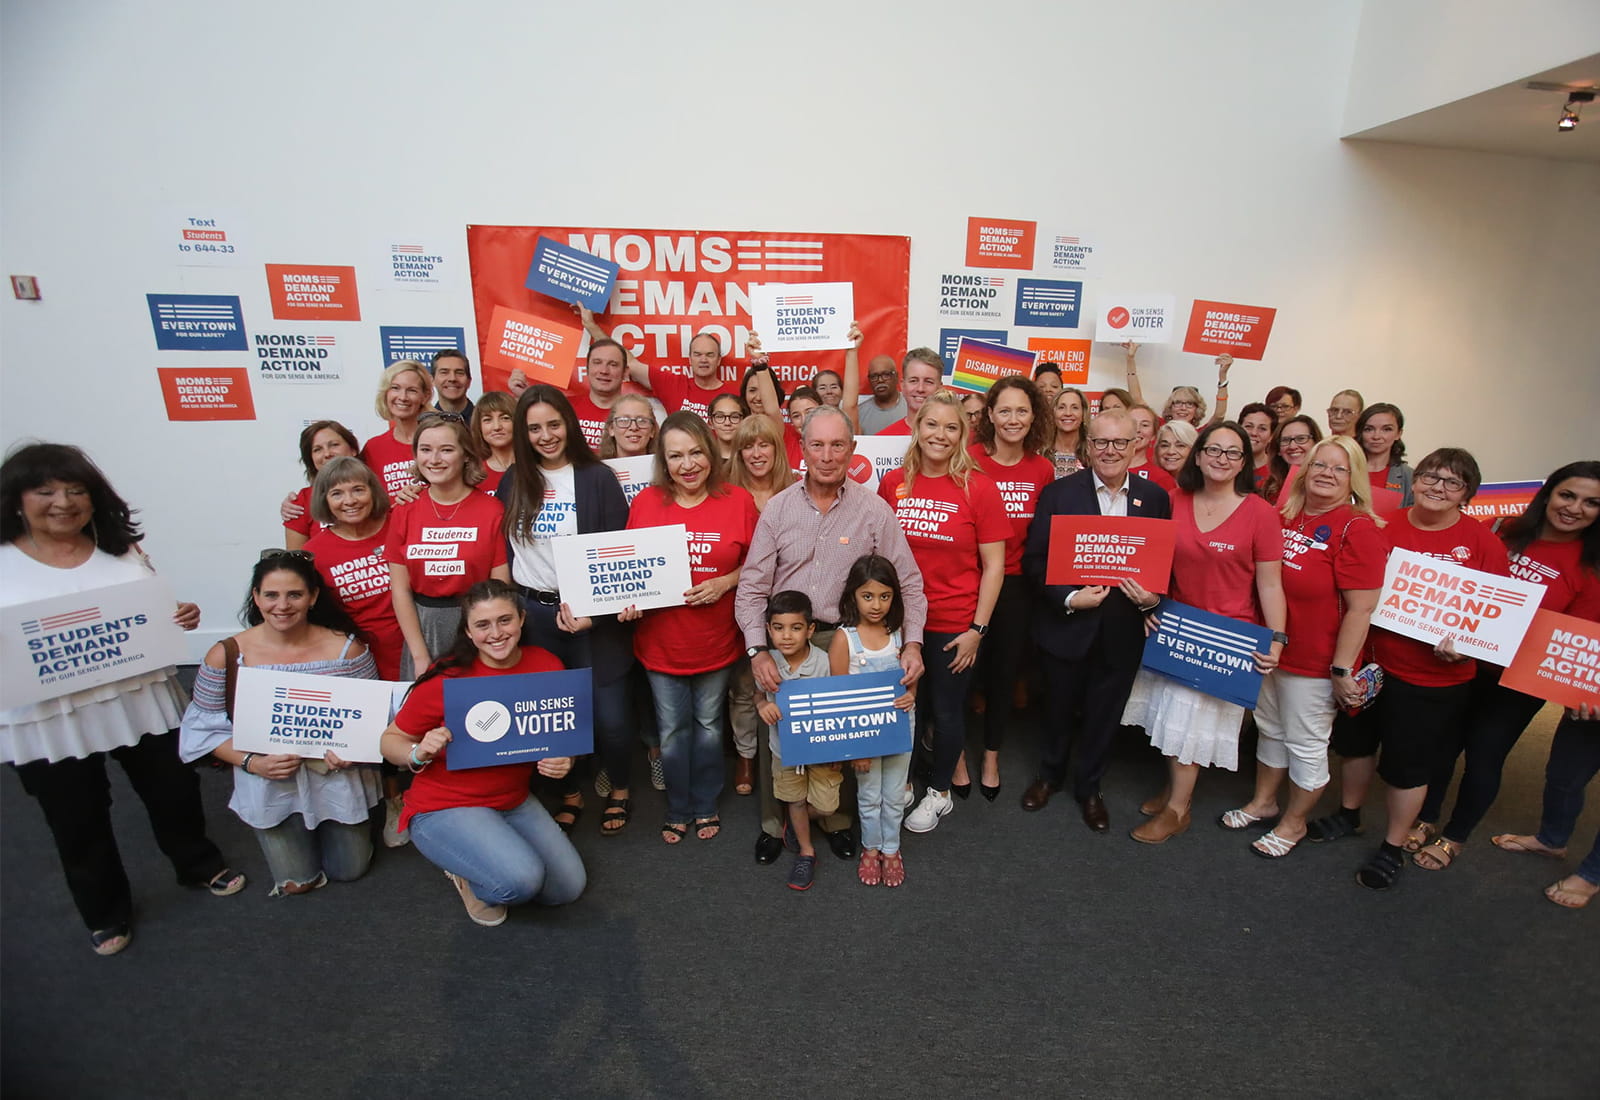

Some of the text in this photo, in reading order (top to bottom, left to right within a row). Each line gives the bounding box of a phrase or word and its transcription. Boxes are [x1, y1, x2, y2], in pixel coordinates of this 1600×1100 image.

[188, 218, 216, 227] Text
[186, 232, 222, 240] Students
[980, 236, 1018, 244] DEMAND
[194, 244, 235, 253] 644-33
[568, 234, 732, 272] MOMS
[979, 244, 1012, 252] ACTION
[1054, 244, 1093, 253] STUDENTS
[392, 255, 443, 263] STUDENTS
[282, 275, 319, 284] MOMS
[538, 264, 606, 294] EVERYTOWN
[941, 274, 982, 285] MOMS
[284, 284, 335, 293] DEMAND
[941, 286, 996, 298] DEMAND
[286, 293, 330, 302] ACTION
[609, 280, 754, 316] EMAN
[940, 298, 988, 309] ACTION
[1022, 302, 1074, 310] EVERYTOWN
[776, 306, 836, 317] STUDENTS
[1206, 311, 1240, 322] MOMS
[162, 322, 236, 330] EVERYTOWN
[777, 317, 824, 326] DEMAND
[1132, 317, 1163, 328] VOTER
[1204, 320, 1251, 332] DEMAND
[505, 320, 540, 336] MOMS
[777, 327, 818, 336] ACTION
[1202, 329, 1243, 340] ACTION
[255, 335, 306, 346] MOMS
[503, 330, 554, 351] DEMAND
[258, 348, 328, 358] DEMAND
[500, 340, 544, 359] ACTION
[391, 352, 438, 360] EVERYT
[1048, 350, 1065, 361] CAN
[1068, 351, 1084, 361] END
[260, 361, 320, 371] ACTION
[965, 359, 998, 375] DISARM
[1057, 362, 1084, 372] OLENCE
[720, 366, 736, 381] IN
[996, 482, 1015, 491] MS
[1000, 492, 1030, 501] AND
[898, 498, 934, 509] MOMS
[537, 512, 565, 522] AND
[896, 508, 948, 522] DEMAND
[533, 523, 556, 532] ION
[899, 519, 939, 532] CTION
[427, 530, 472, 539] Students
[930, 533, 954, 542] AMERICA
[1076, 534, 1120, 543] MOMS
[410, 547, 454, 556] Demand
[1075, 544, 1136, 555] DEMAND
[330, 554, 378, 576] MOMS
[588, 556, 666, 573] STUDENTS
[1074, 554, 1127, 565] ACTION
[429, 563, 461, 572] Action
[1509, 564, 1542, 582] AND
[334, 563, 390, 586] DEMAN
[590, 569, 652, 584] DEMAND
[1398, 560, 1478, 595] MOMS
[592, 581, 646, 596] ACTION
[1391, 576, 1501, 619] DEMAND
[1384, 594, 1480, 633] ACTION
[28, 614, 148, 650] STUDENTS
[1379, 608, 1499, 652] FOR GUN SENSE IN AMERICA
[1551, 629, 1600, 653] MOM
[32, 631, 130, 664] DEMAND
[1156, 633, 1253, 673] EVERYTOWN
[1546, 642, 1600, 669] DEM
[39, 646, 122, 677] ACTION
[59, 671, 75, 680] GUN
[77, 664, 100, 676] SENSE
[113, 653, 144, 667] AMERICA
[1169, 650, 1234, 676] FOR GUN SAFETY
[1538, 656, 1600, 685] ACTI
[1536, 669, 1598, 694] FOR GUN SENSE
[515, 696, 574, 713] GUN SENSE
[273, 702, 362, 719] STUDENTS
[272, 714, 343, 729] DEMAND
[515, 710, 575, 736] VOTER
[791, 711, 897, 734] EVERYTOWN
[270, 726, 333, 739] ACTION
[848, 729, 880, 739] SAFETY
